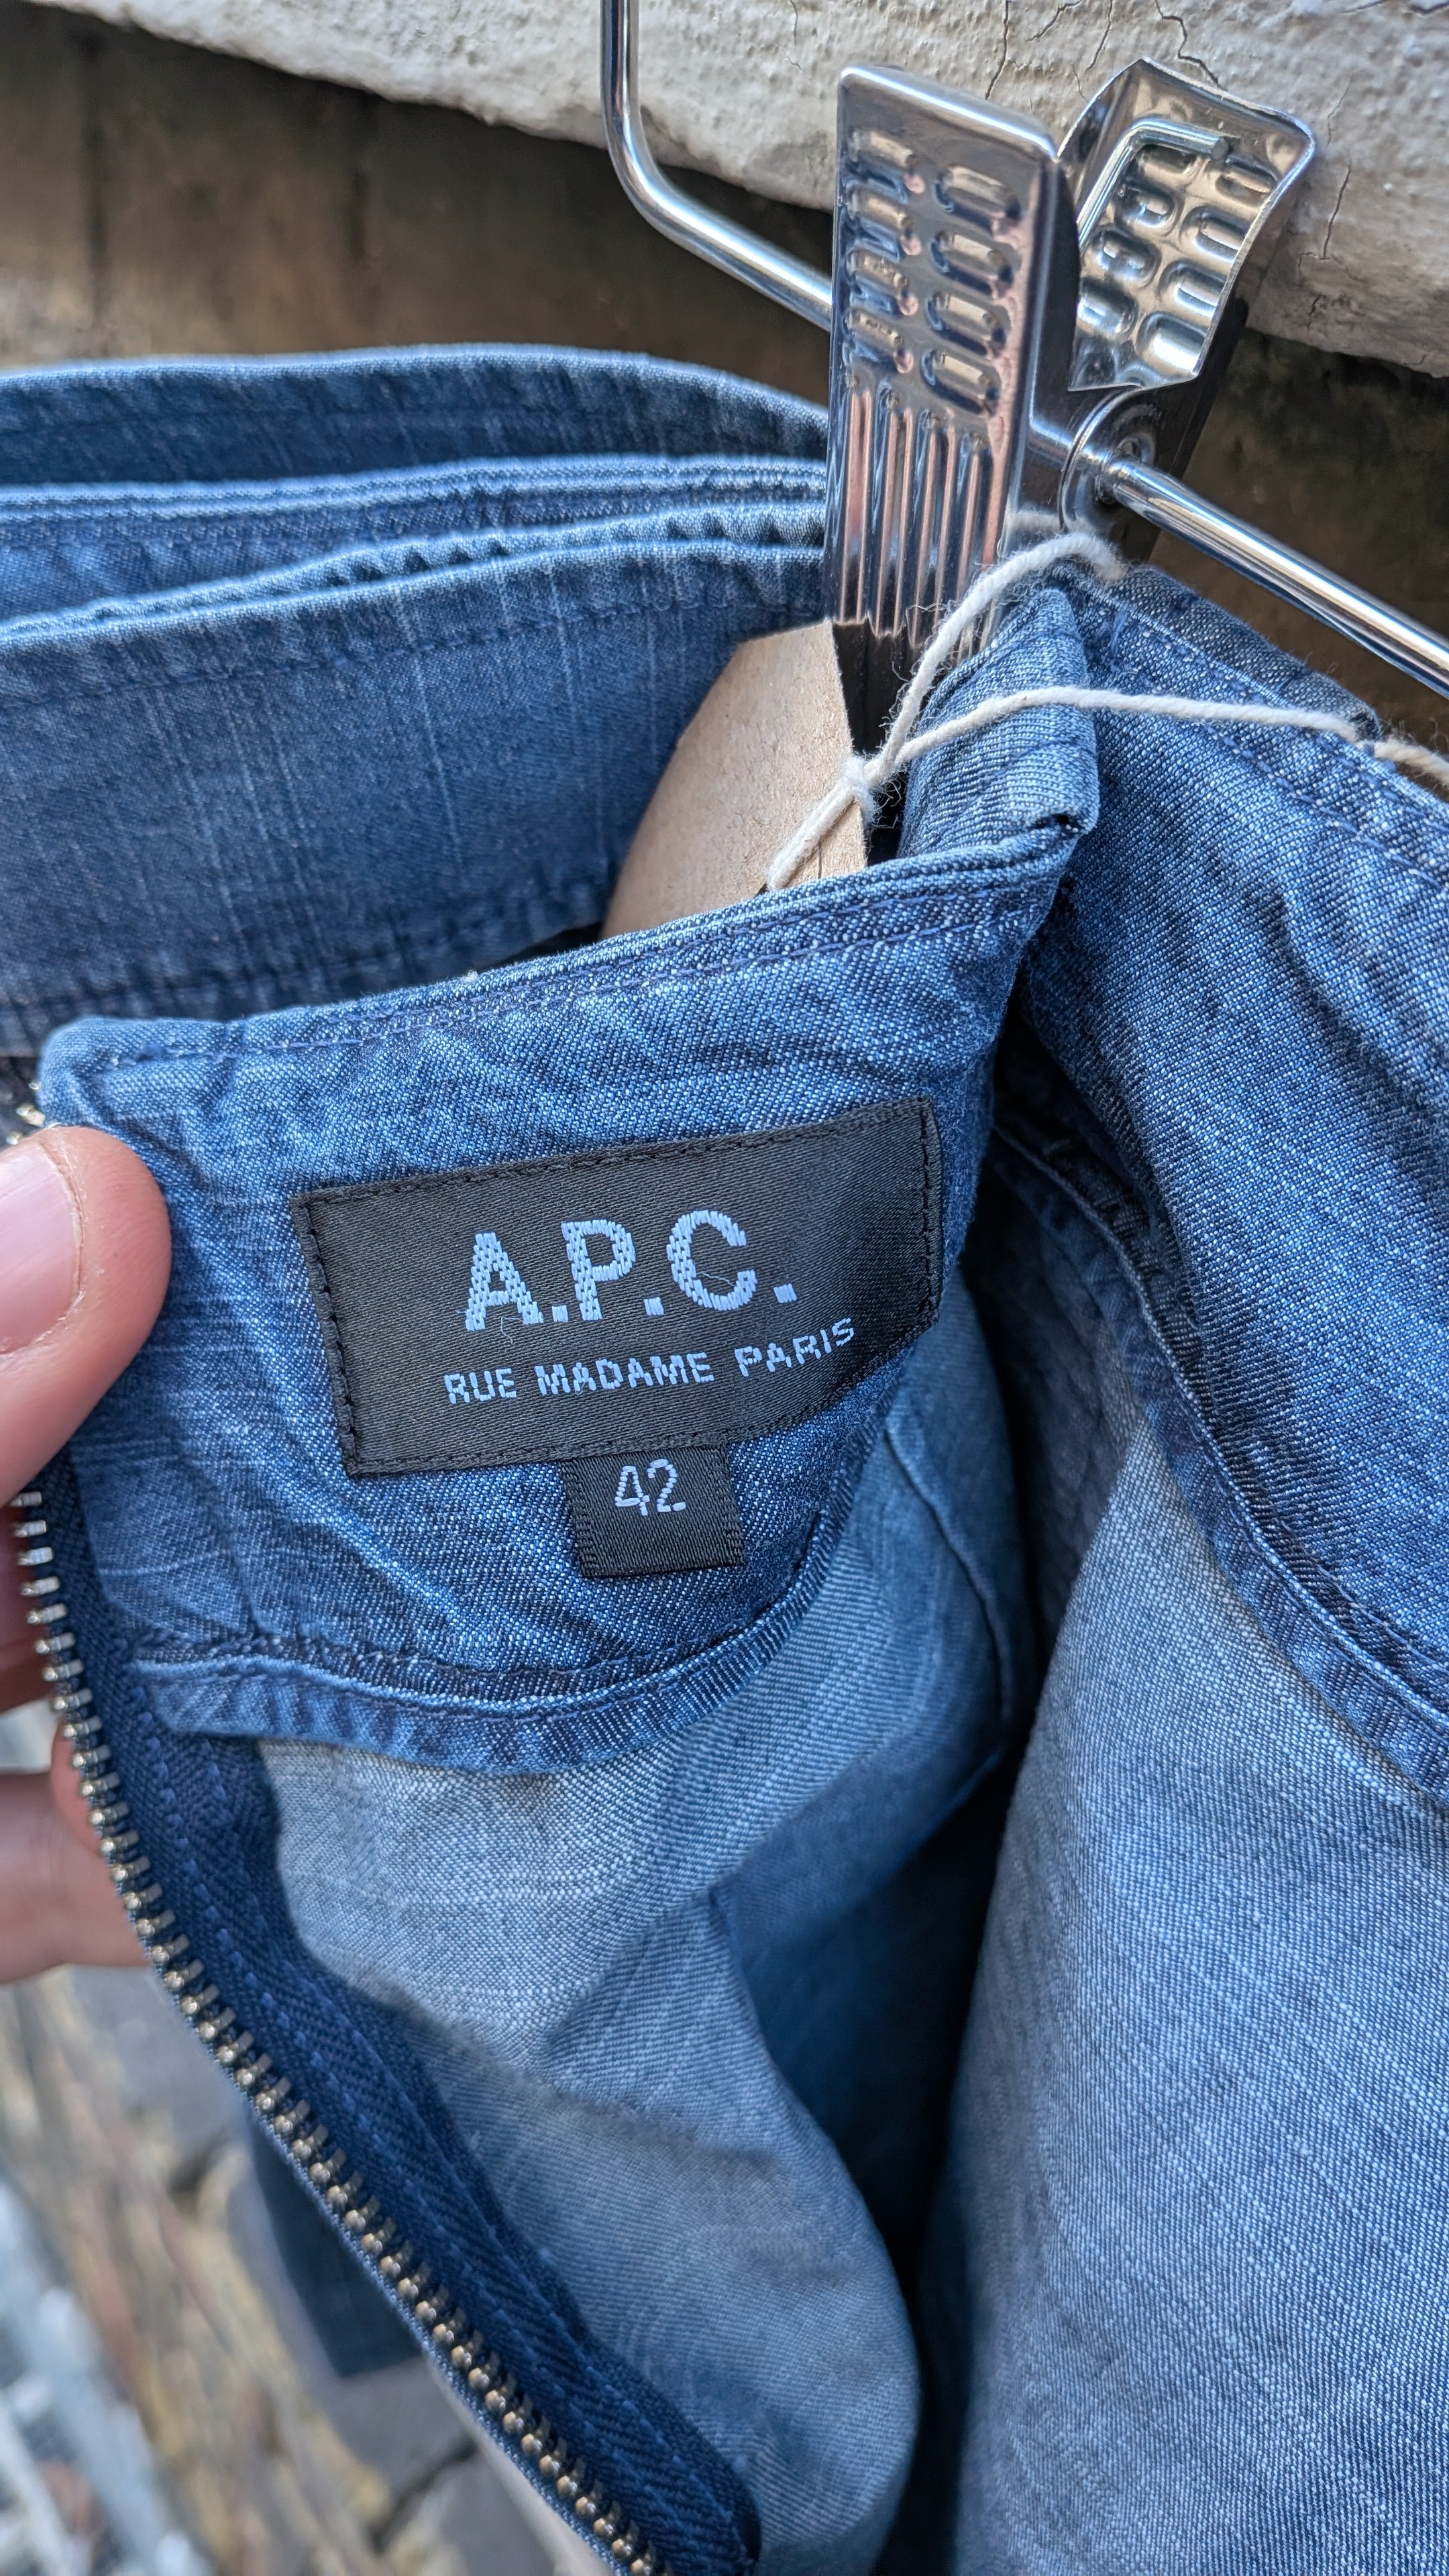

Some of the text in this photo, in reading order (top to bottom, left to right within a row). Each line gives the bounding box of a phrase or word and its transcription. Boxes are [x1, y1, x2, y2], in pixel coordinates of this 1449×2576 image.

[464, 1209, 798, 1332] A.P.C.
[443, 1317, 855, 1405] RUE MADAME PARIS
[613, 1458, 688, 1517] 42
